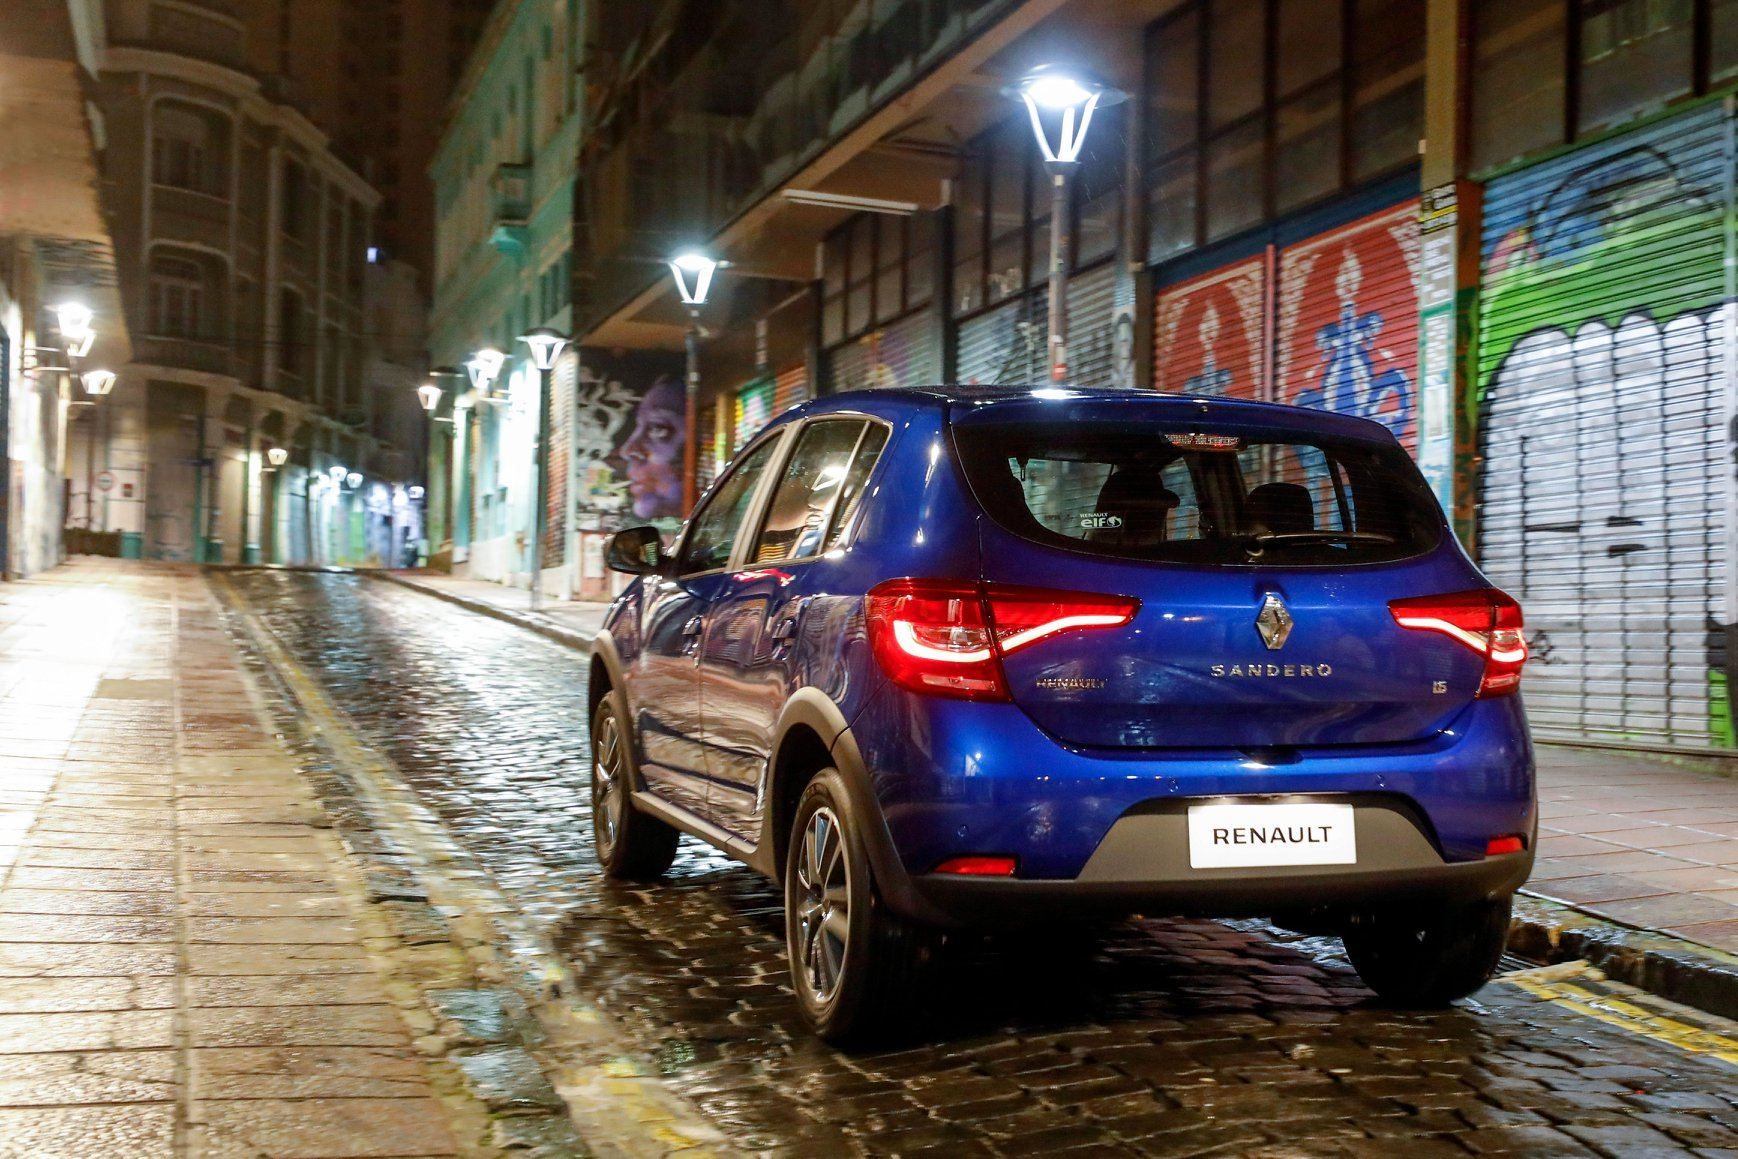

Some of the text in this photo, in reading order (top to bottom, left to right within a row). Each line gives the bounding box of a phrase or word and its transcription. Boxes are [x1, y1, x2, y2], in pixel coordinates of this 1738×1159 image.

[1080, 518, 1107, 528] elf
[1210, 664, 1333, 677] SANDERO
[1036, 678, 1108, 689] RENAULT
[1213, 826, 1333, 845] RENAULT
